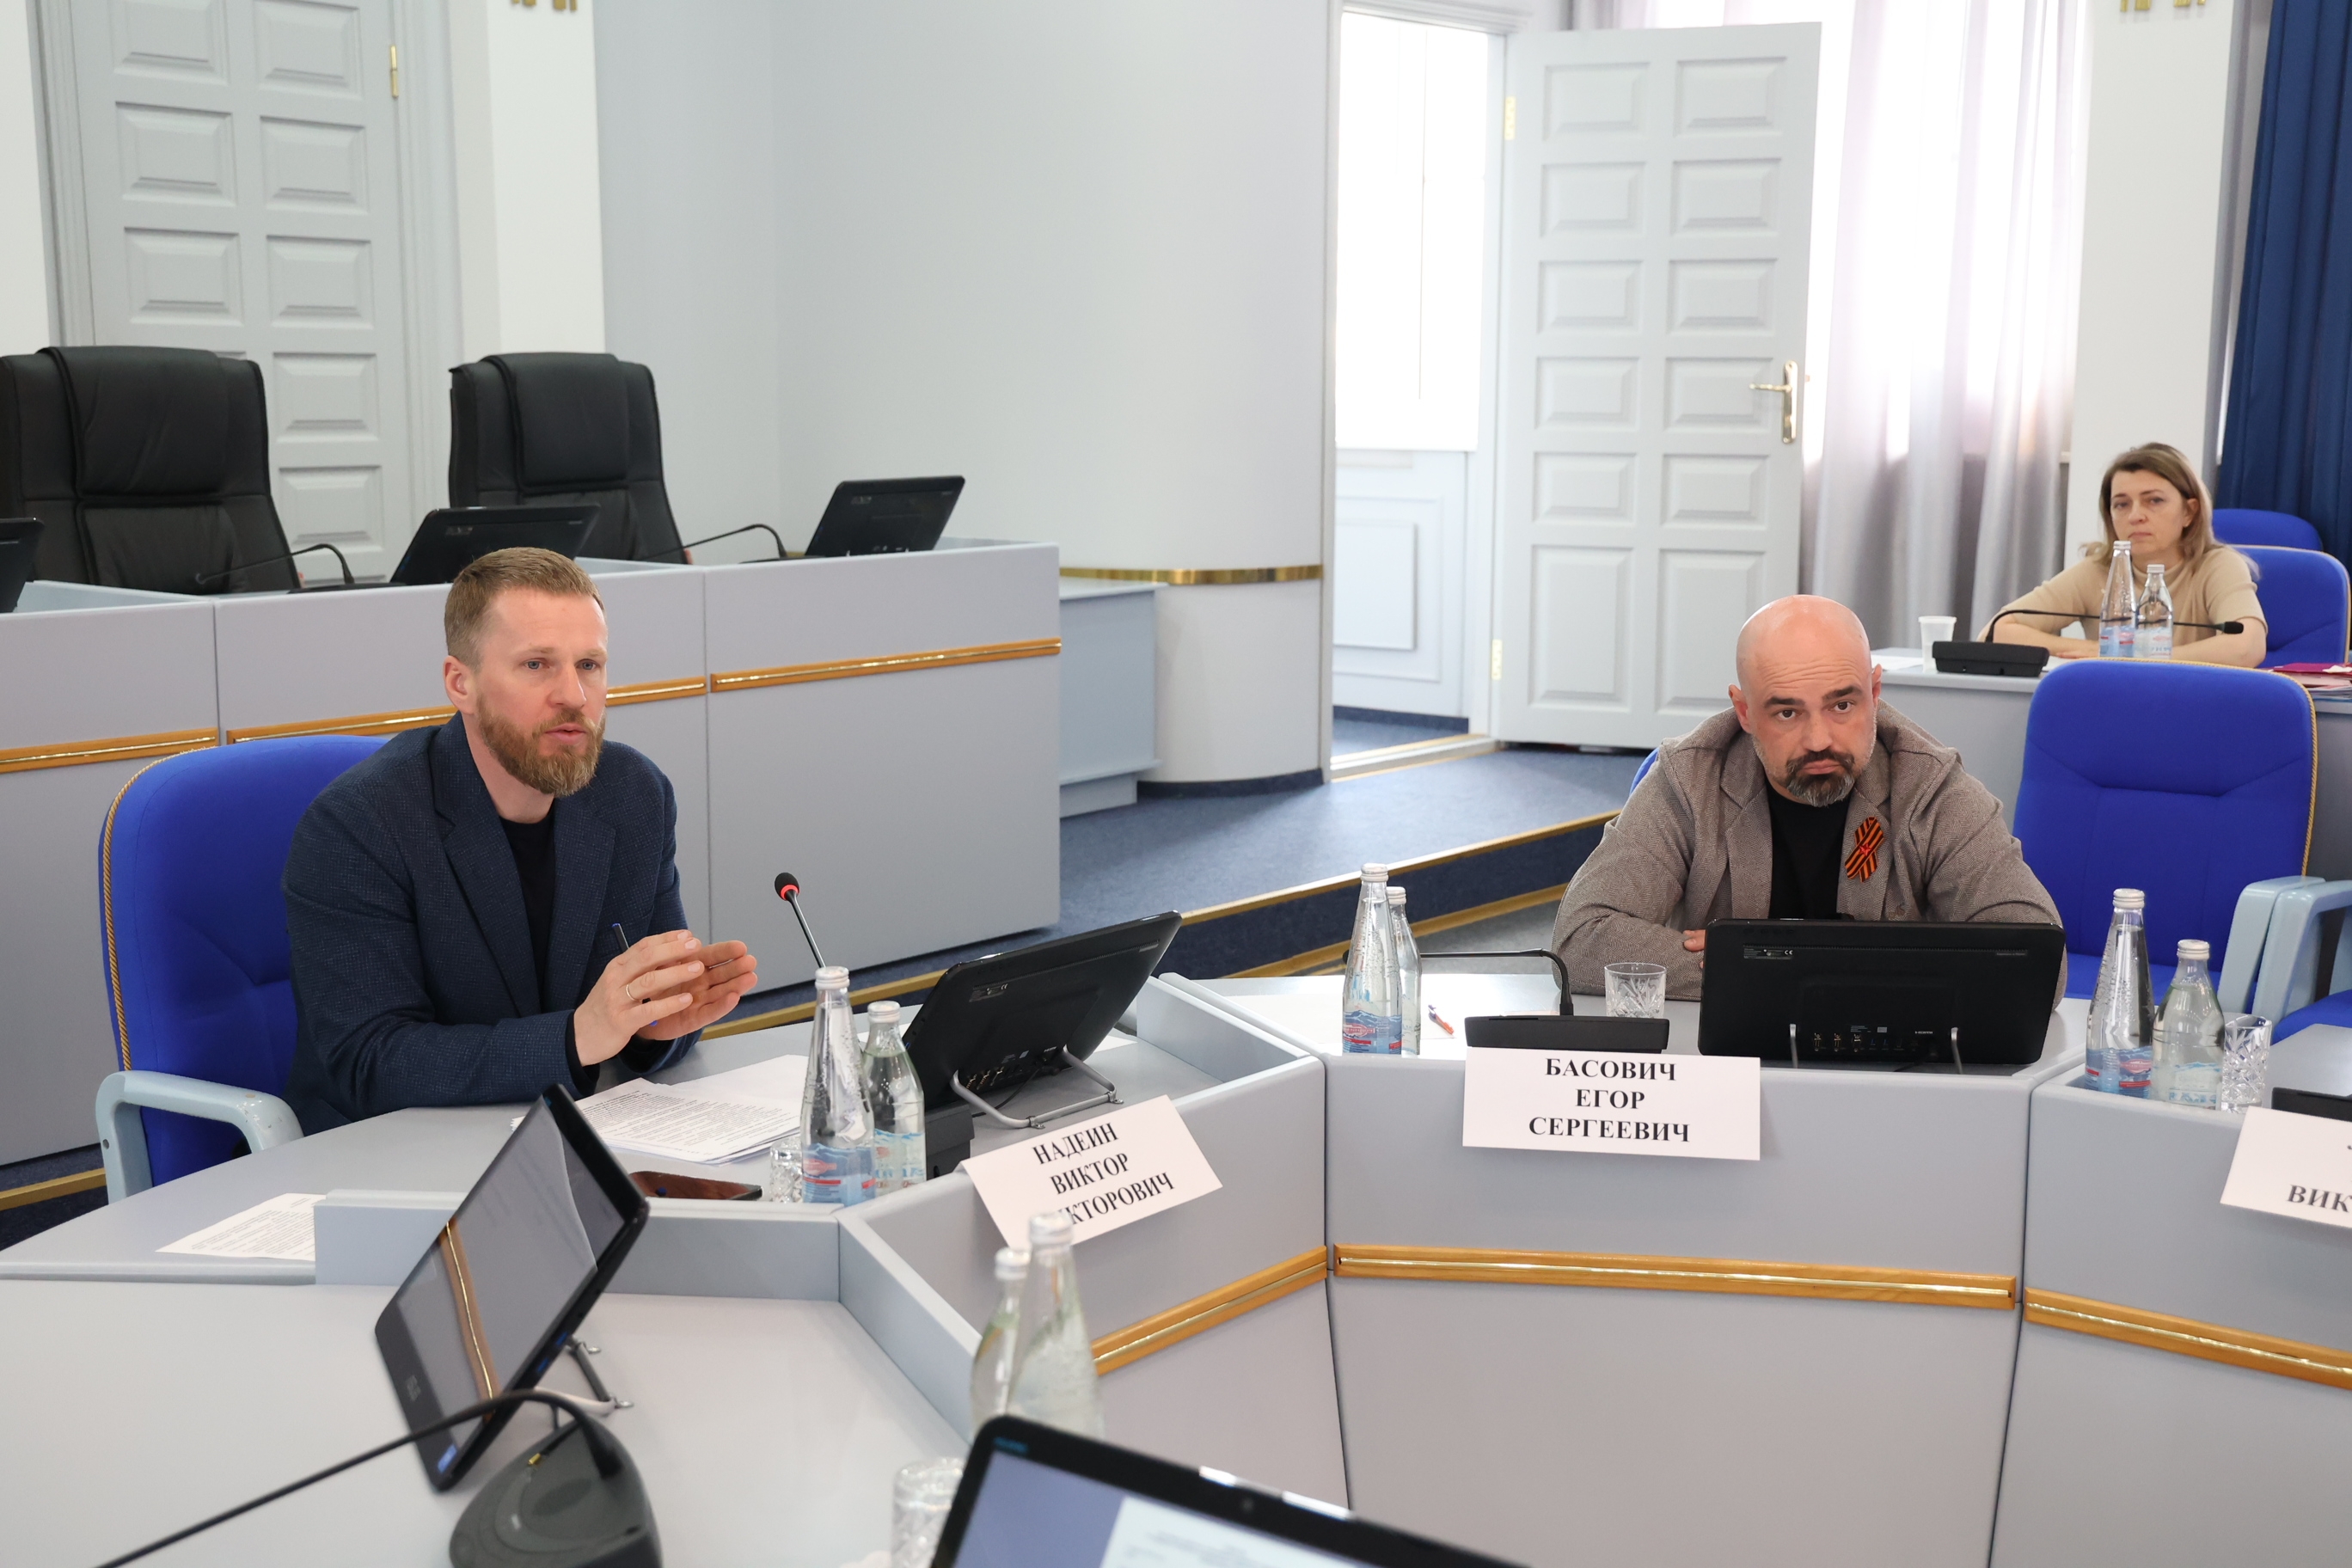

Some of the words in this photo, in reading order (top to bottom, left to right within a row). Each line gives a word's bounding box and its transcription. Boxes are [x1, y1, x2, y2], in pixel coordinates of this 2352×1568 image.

[1545, 1057, 1676, 1081] БАСОВИЧ
[1575, 1088, 1645, 1110] ЕГОР
[1032, 1122, 1119, 1165] НАДЕИН
[1528, 1116, 1690, 1142] СЕРГЕЕВИЧ
[1049, 1153, 1130, 1195] ВИКТОР
[1057, 1171, 1175, 1225] КТОРОВИЧ
